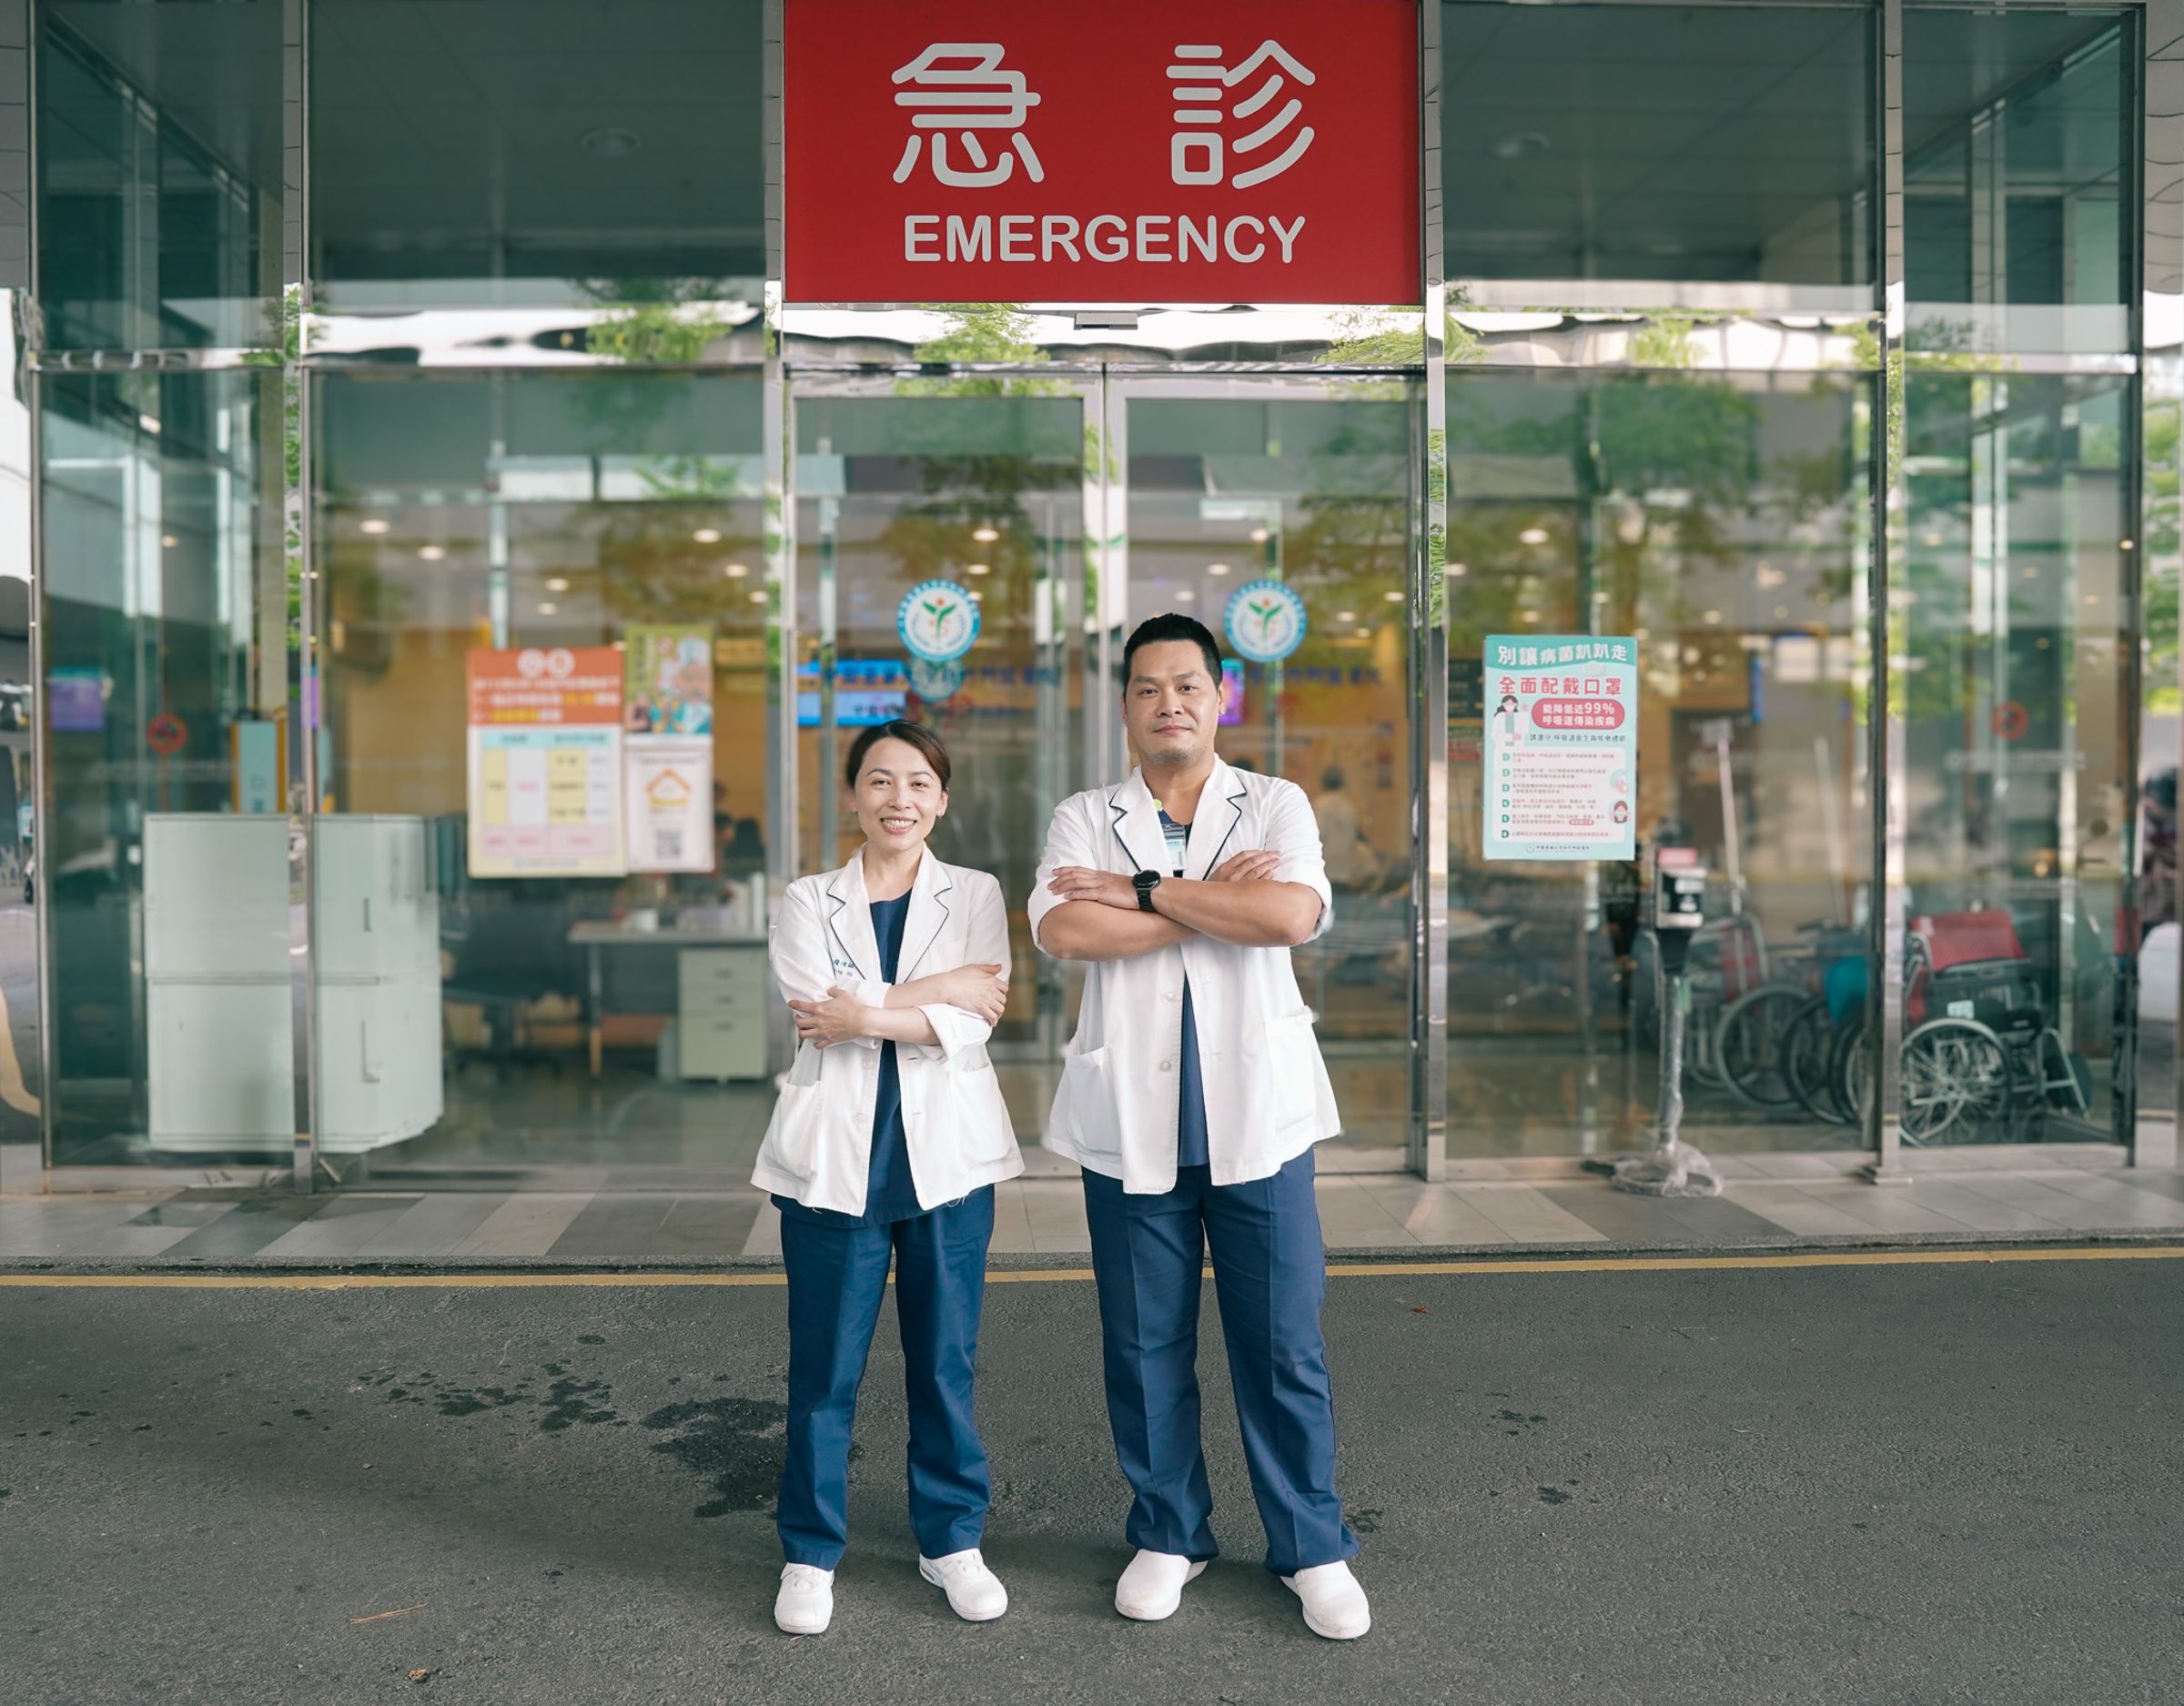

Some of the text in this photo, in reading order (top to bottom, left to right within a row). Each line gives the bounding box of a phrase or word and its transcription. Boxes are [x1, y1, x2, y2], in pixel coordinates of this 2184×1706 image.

[891, 39, 1316, 189] 急診
[904, 215, 1306, 264] EMERGENCY
[1498, 643, 1628, 666] 別讓病菌趴趴走
[1500, 677, 1622, 695] 全面配戴口罩
